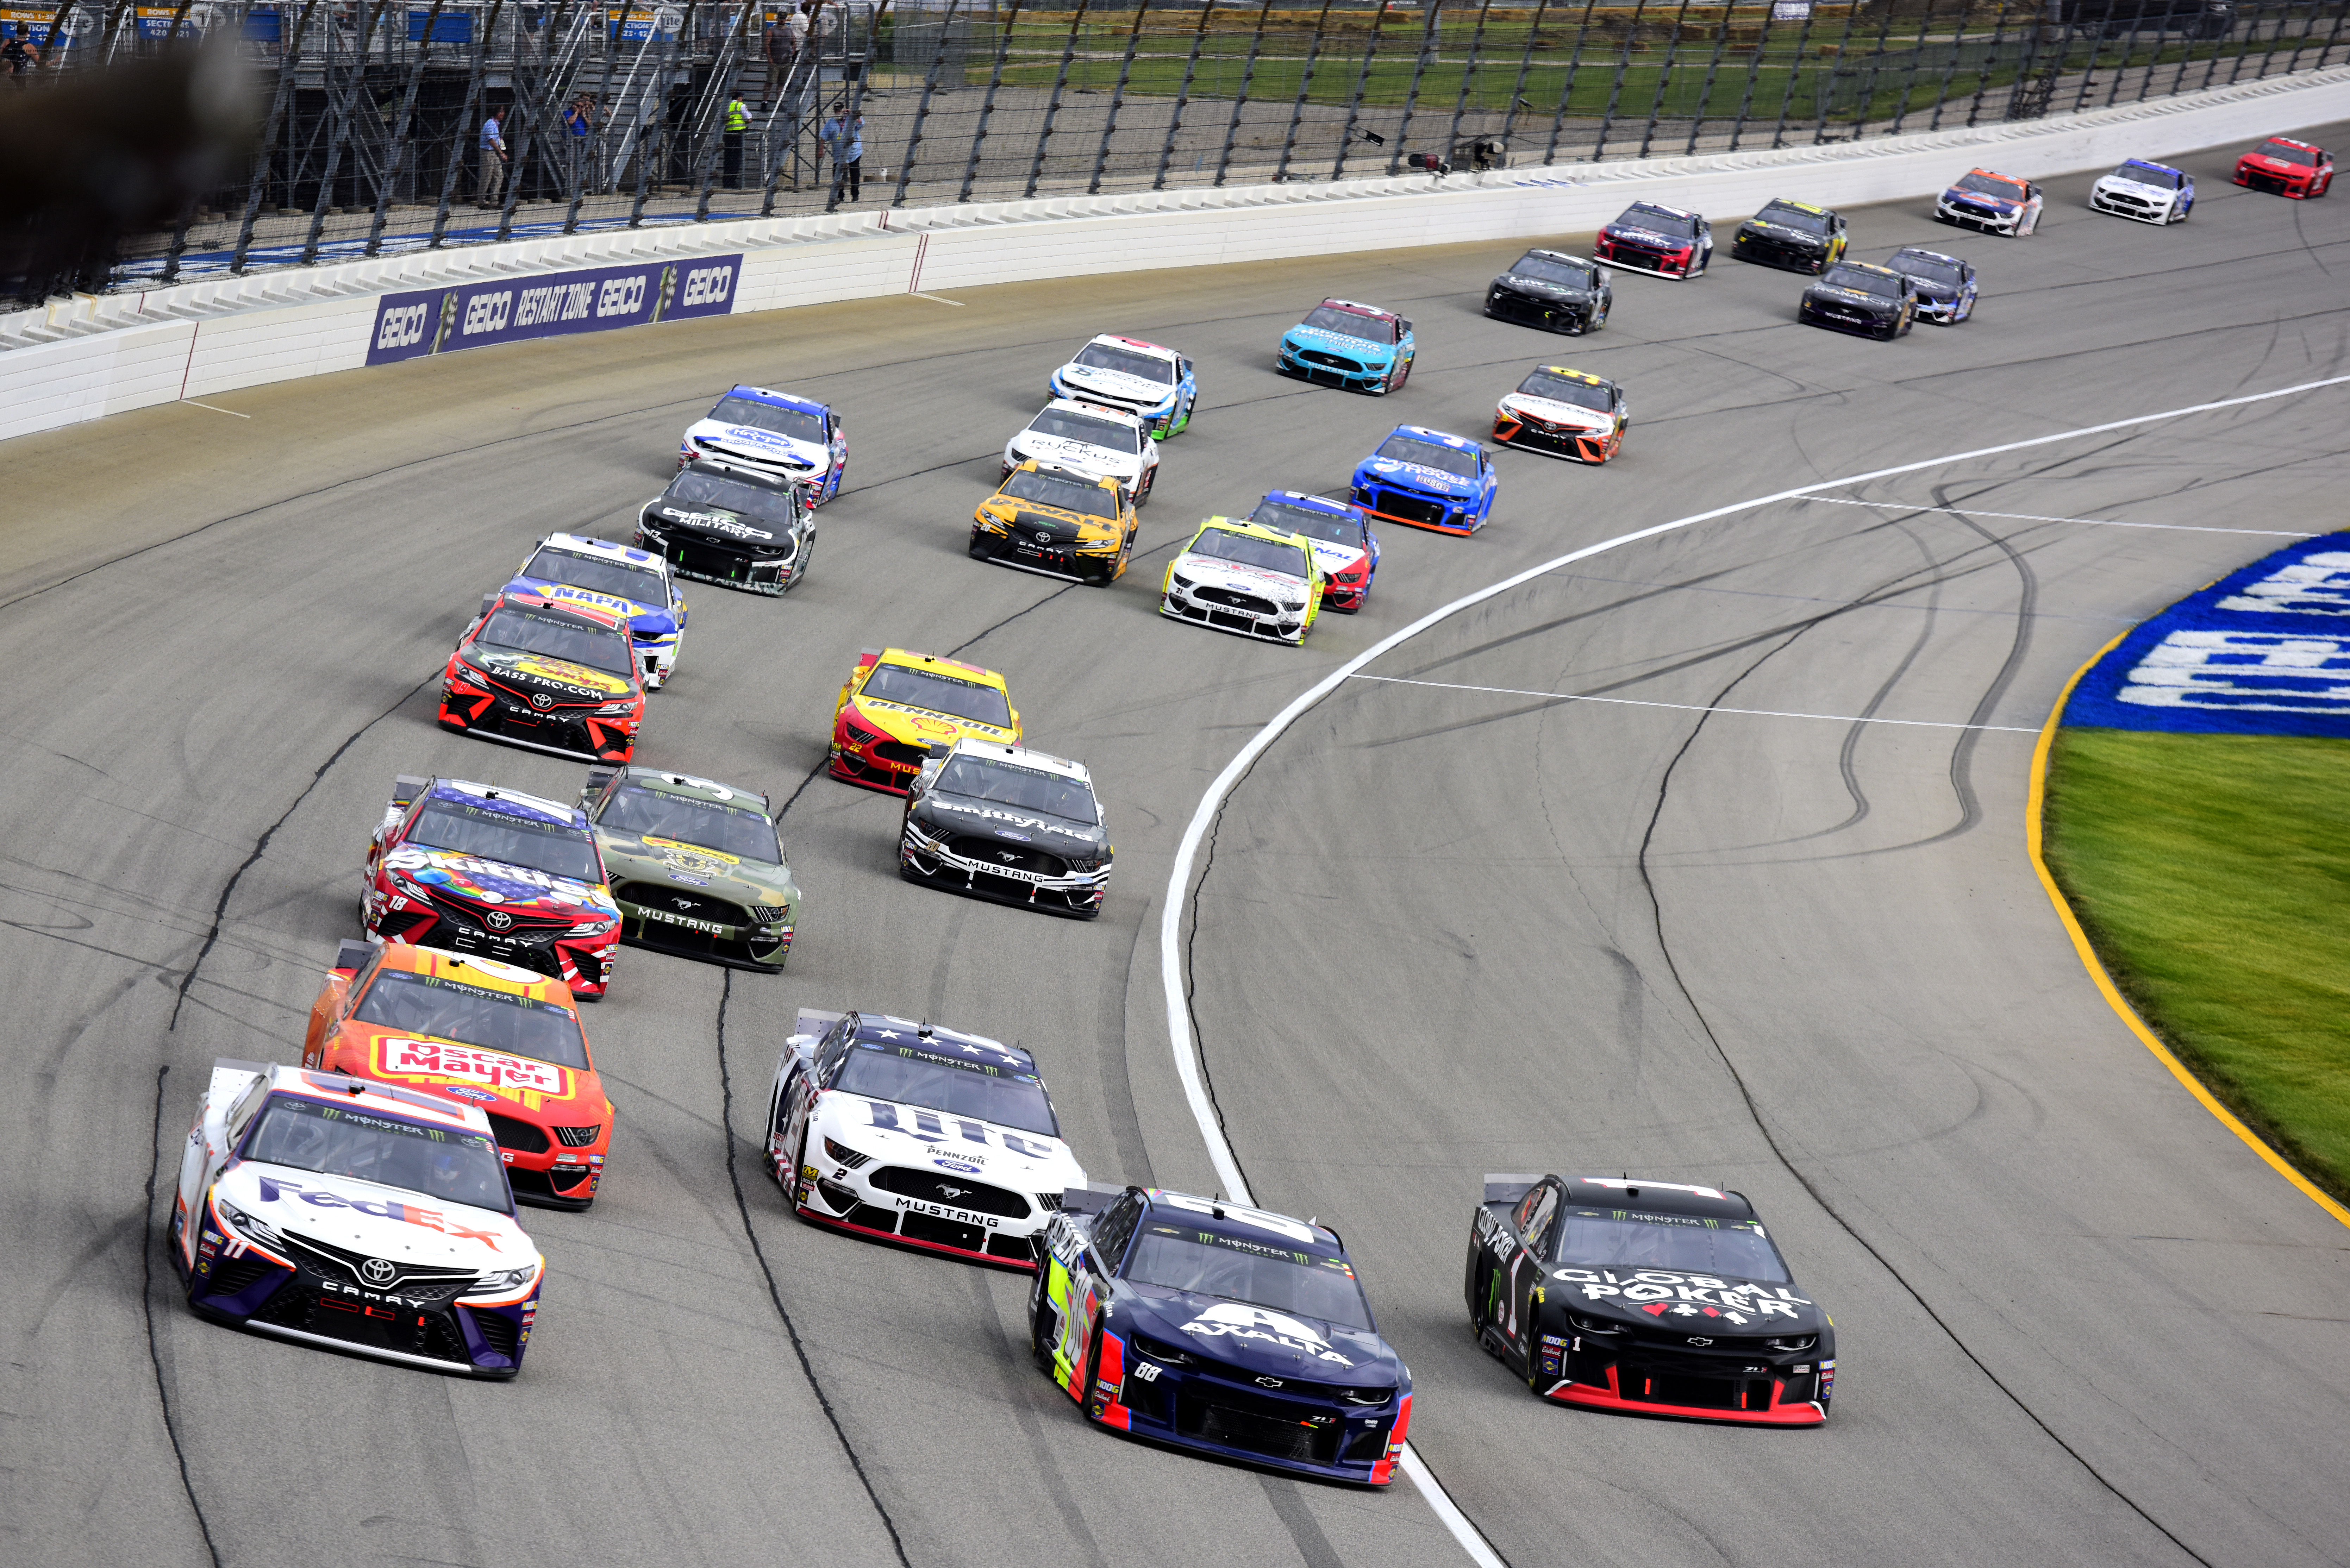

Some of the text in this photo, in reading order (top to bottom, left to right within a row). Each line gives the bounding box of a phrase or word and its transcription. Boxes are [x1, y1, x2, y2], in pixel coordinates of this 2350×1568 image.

[683, 265, 733, 307] GEICO
[462, 275, 647, 335] GEICO RESTART ZONE GEICO
[377, 303, 428, 350] GEICO
[1308, 362, 1350, 376] MUSTANG
[734, 429, 788, 446] Kroger
[1530, 428, 1567, 440] CAMRY
[720, 438, 788, 457] KROGER.COM
[1032, 440, 1120, 464] RUCKUS
[1048, 476, 1082, 487] MONSTER
[662, 507, 773, 540] GEICO
[679, 516, 751, 539] MILITARY
[980, 523, 991, 532] 20
[649, 529, 661, 539] 13
[1237, 533, 1272, 544] MONSTER
[1019, 541, 1064, 554] CAMRY
[584, 554, 625, 567] MONSTER
[554, 587, 627, 614] NAPA
[1206, 602, 1261, 620] MUSTANG
[538, 616, 584, 631] MONSTER
[491, 666, 603, 700] BASS PRO.COM
[921, 671, 964, 685] MONSTER
[454, 681, 470, 694] 19
[509, 706, 570, 723] CAMRY
[865, 699, 1006, 737] PENNZOIL
[849, 742, 863, 753] 22
[999, 763, 1046, 777] MONSTER
[670, 795, 722, 810] MONSTER
[482, 810, 539, 828] MONSTER
[932, 800, 1094, 842] Smithfield
[1002, 831, 1024, 840] Ford
[924, 840, 940, 852] 10
[676, 876, 701, 884] Ford
[968, 860, 1044, 883] MUSTANG
[384, 849, 622, 916] Skittles
[389, 895, 408, 911] 18
[637, 907, 723, 934] MUSTANG
[458, 928, 533, 948] CAMRY
[445, 981, 513, 1002] MONSTER
[407, 1042, 543, 1073] Oscar
[917, 1051, 981, 1070] MONSTER
[400, 1053, 552, 1089] Mayer
[454, 1087, 489, 1100] Ford
[345, 1113, 424, 1135] MONSTER
[860, 1100, 1053, 1160] Lite
[927, 1148, 986, 1166] PENNZOIL
[942, 1160, 972, 1172] Ford
[801, 1177, 813, 1185] LINCOLN
[832, 1168, 848, 1181] 2
[259, 1177, 504, 1253] FedEx
[896, 1197, 999, 1228] MUSTANG
[1632, 1213, 1700, 1225] MONSTER
[202, 1229, 224, 1246] MOOG
[223, 1238, 252, 1259] 11
[1219, 1237, 1289, 1258] MONSTER
[322, 1281, 425, 1309] CAMRY
[1552, 1268, 1812, 1305] GLOBAL
[1581, 1283, 1799, 1319] POKER
[1179, 1322, 1355, 1366] AXALTA
[1541, 1334, 1568, 1347] MOOG
[1573, 1336, 1581, 1351] 1
[1542, 1346, 1561, 1356] Edelbrock
[1134, 1362, 1163, 1382] 88
[1096, 1379, 1120, 1394] MOOG
